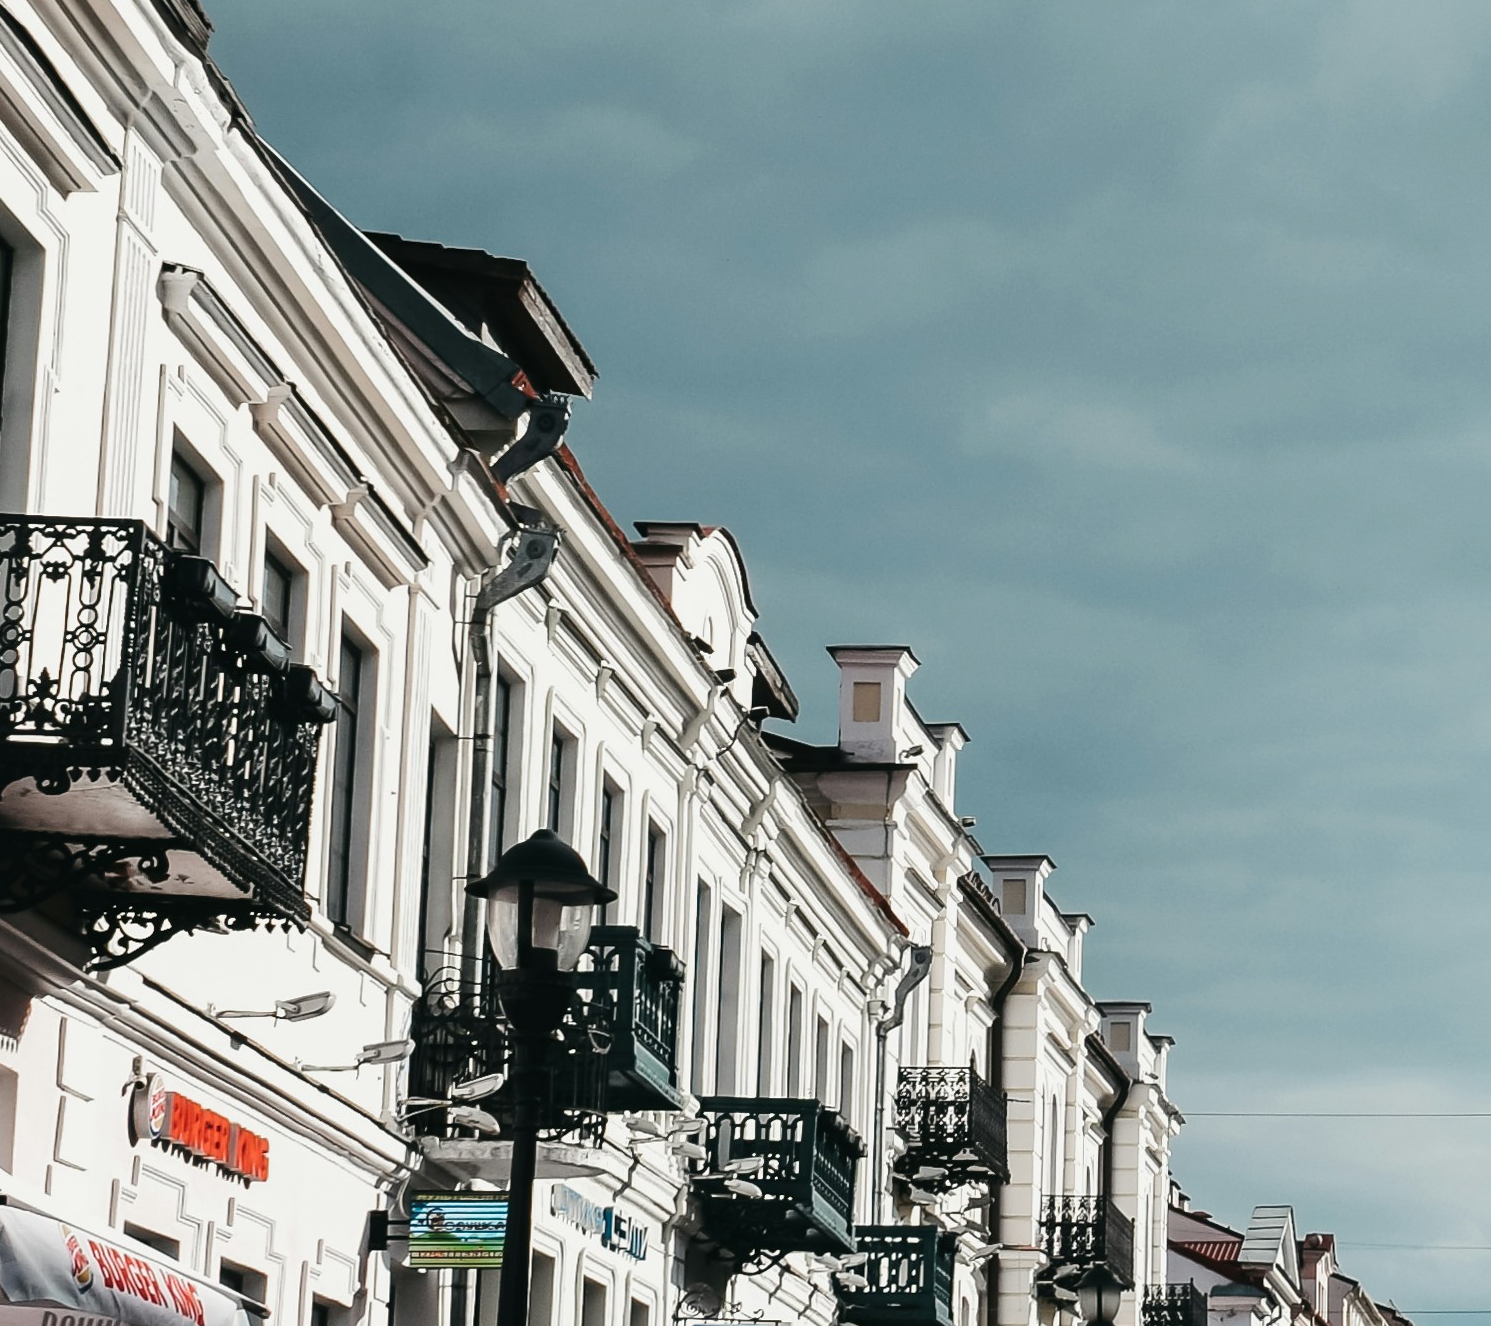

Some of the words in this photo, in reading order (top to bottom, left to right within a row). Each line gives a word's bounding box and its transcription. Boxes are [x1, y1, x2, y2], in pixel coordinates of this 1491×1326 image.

[171, 1091, 230, 1164] BURGER
[237, 1122, 270, 1183] KING
[87, 1238, 169, 1308] BURGER
